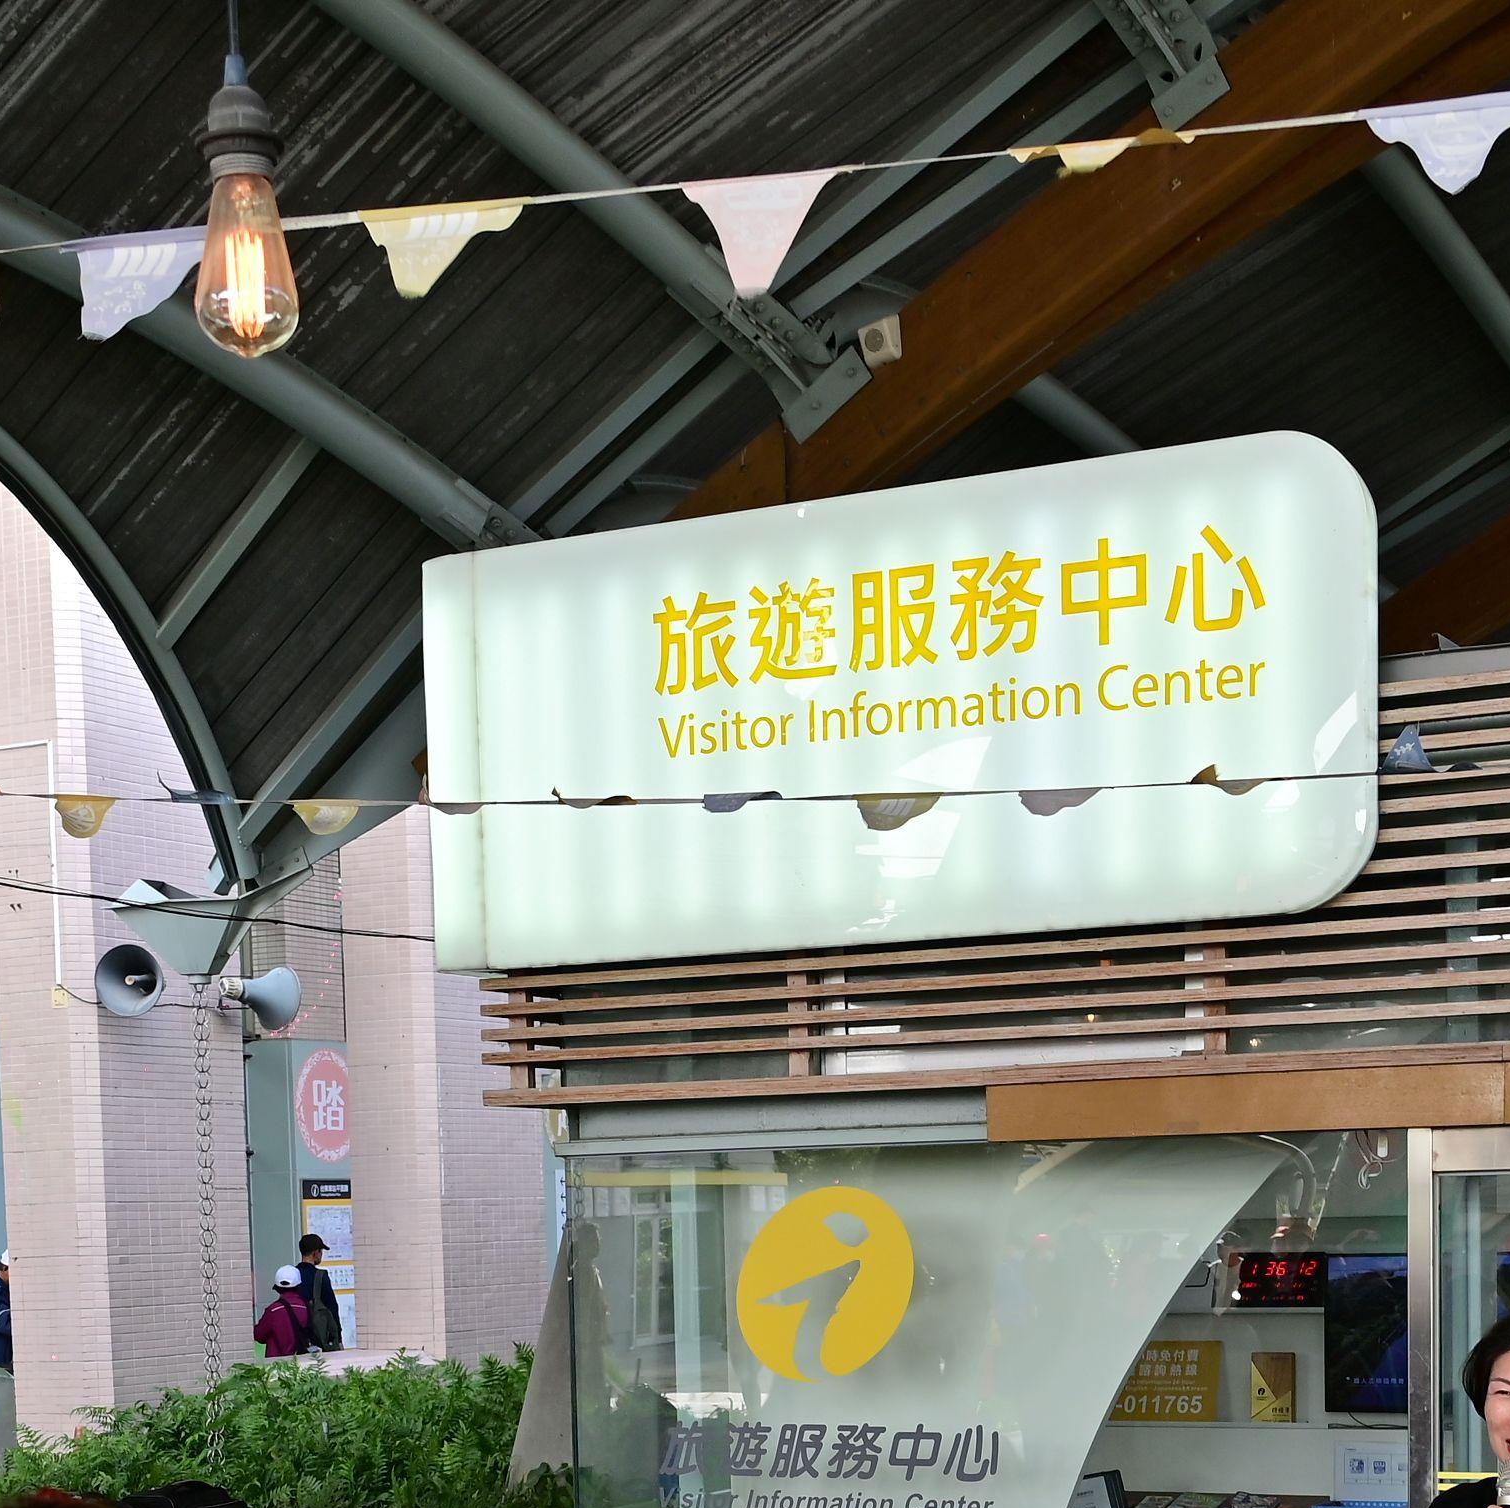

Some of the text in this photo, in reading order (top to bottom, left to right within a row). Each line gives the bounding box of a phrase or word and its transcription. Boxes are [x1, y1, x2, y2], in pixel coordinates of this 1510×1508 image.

[653, 525, 1264, 697] 旅遊服務中心
[658, 658, 1265, 760] Visitor Information Center
[312, 1079, 345, 1131] 踏
[659, 1420, 999, 1483] 旅遊服務中心
